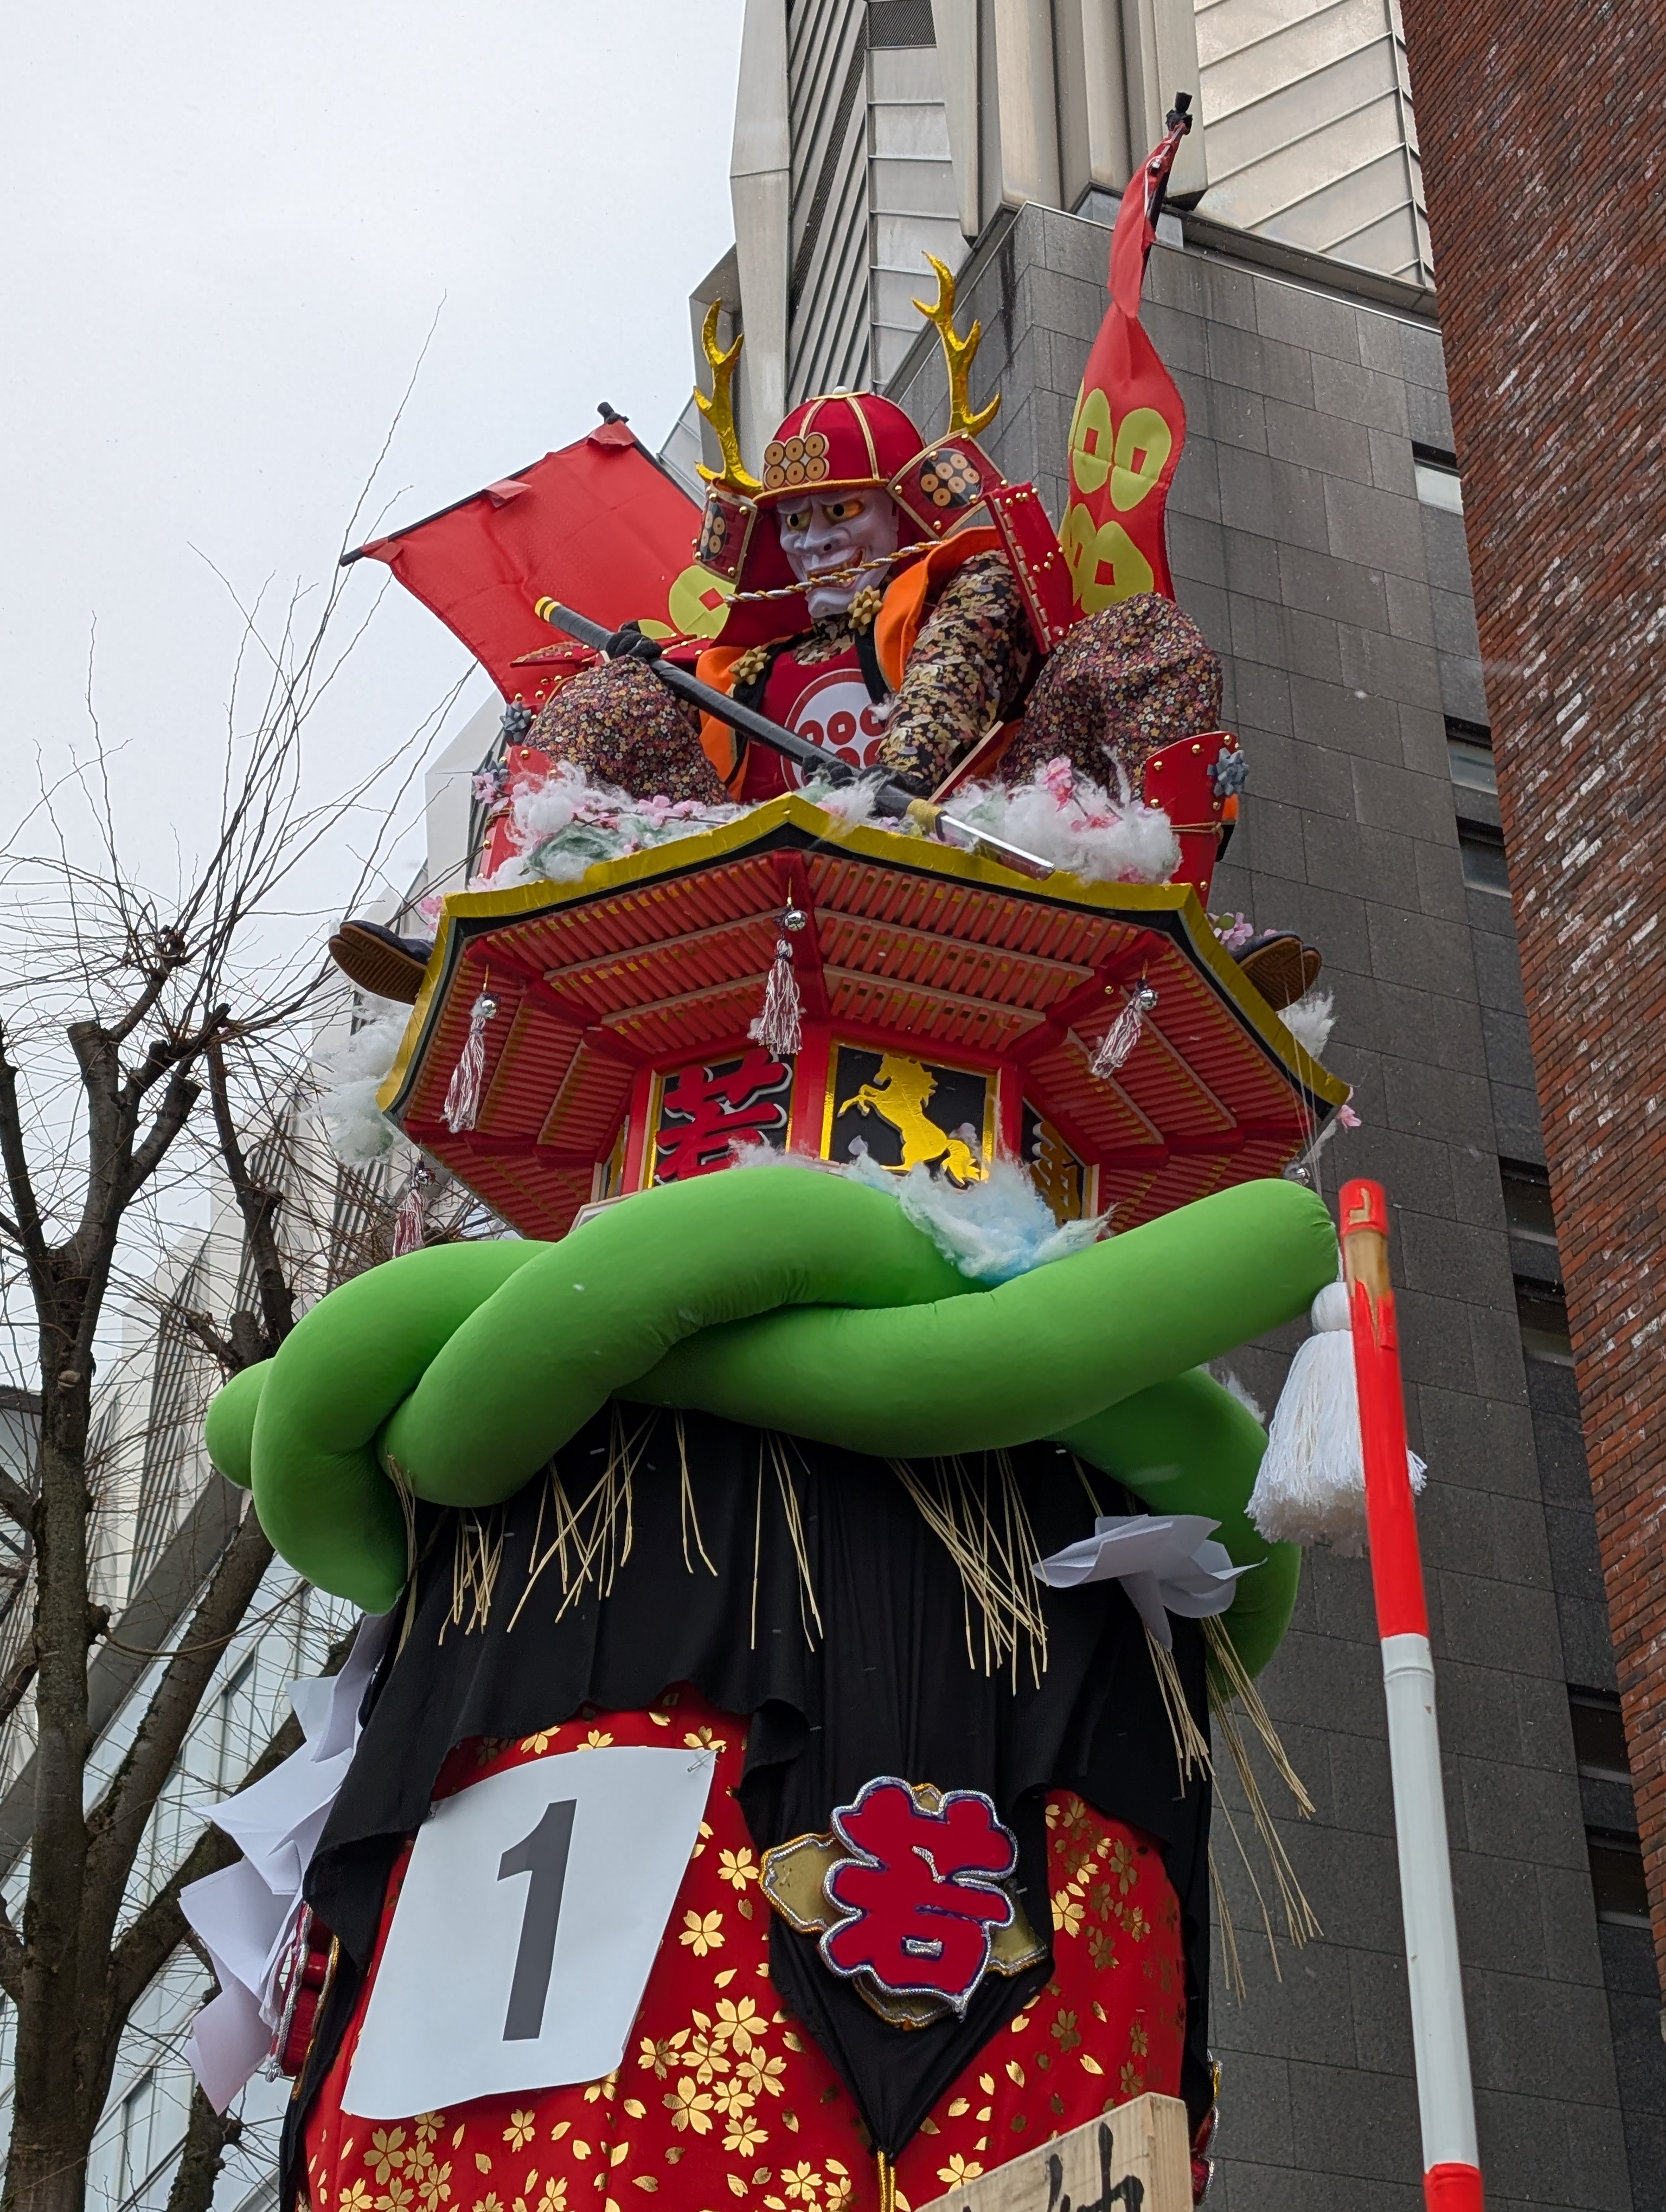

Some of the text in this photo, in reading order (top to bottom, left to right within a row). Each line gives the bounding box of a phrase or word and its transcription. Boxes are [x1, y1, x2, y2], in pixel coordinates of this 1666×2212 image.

[654, 1049, 785, 1180] 若
[497, 1799, 577, 2041] 1
[820, 1777, 1018, 2004] 若
